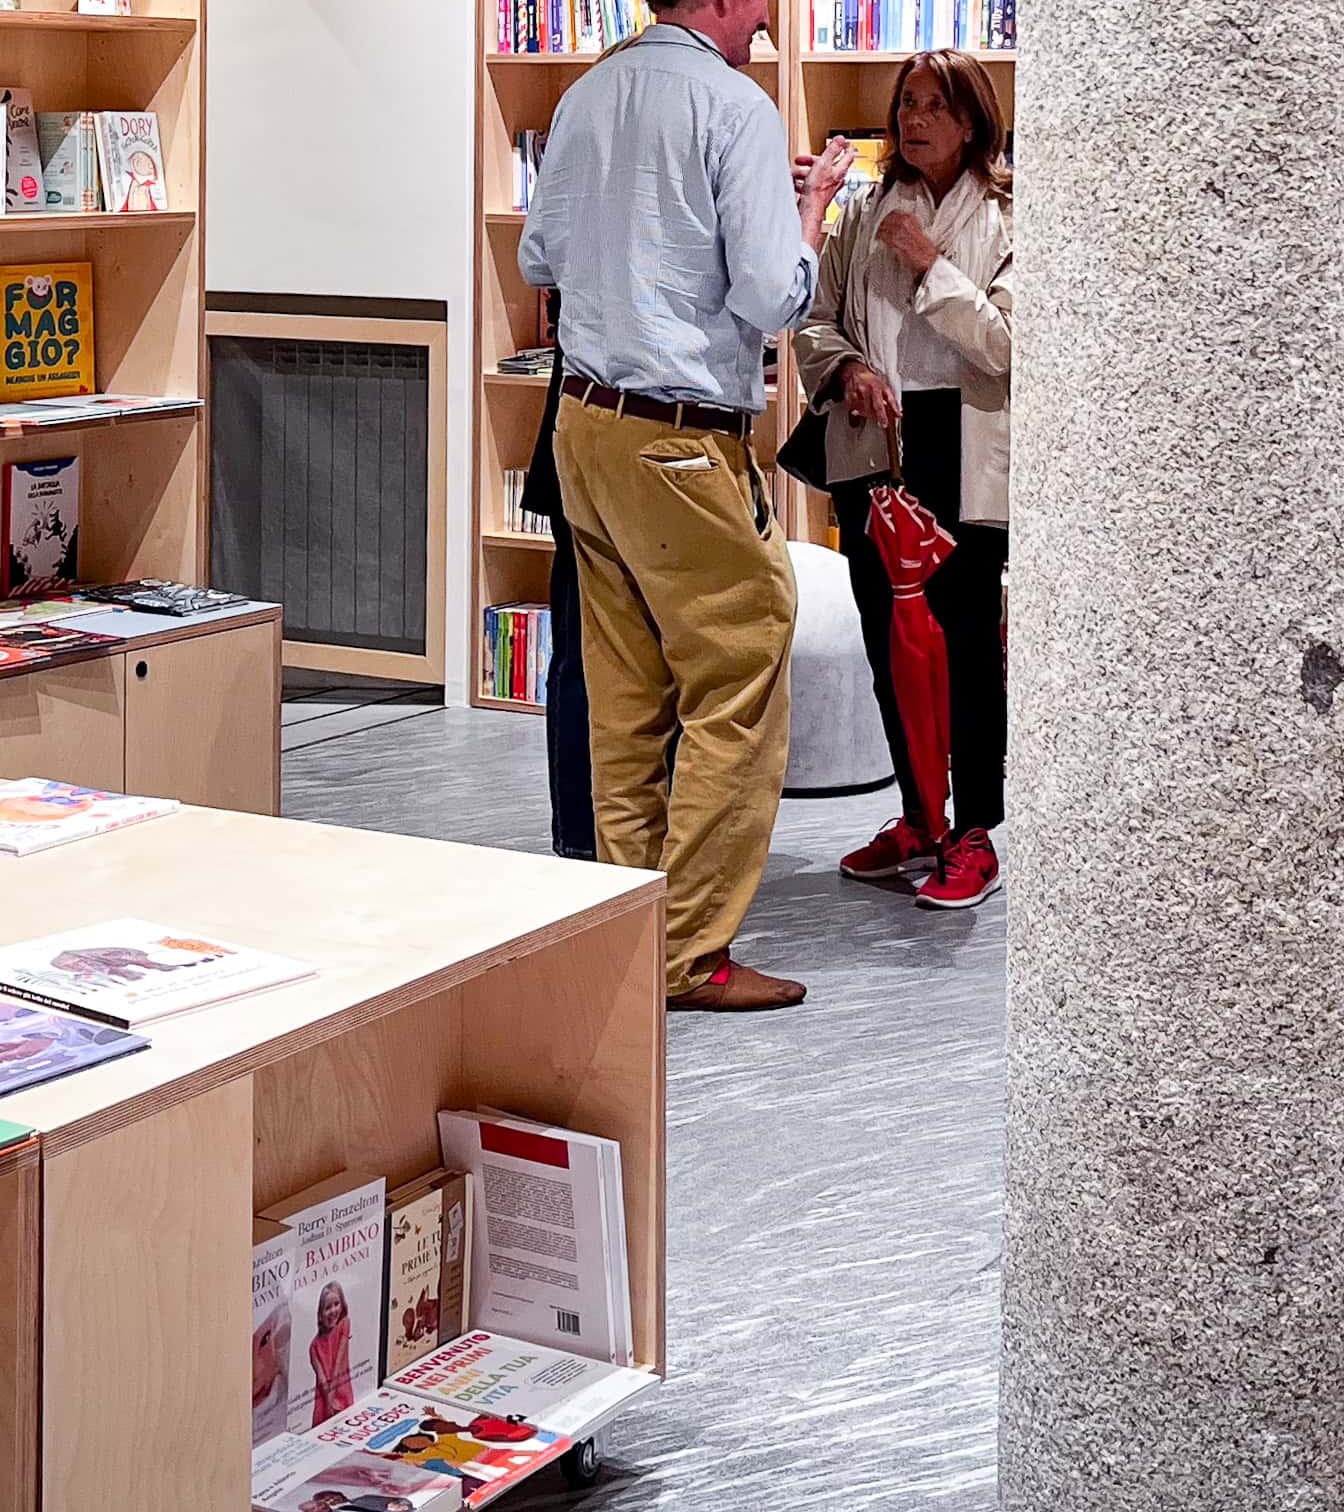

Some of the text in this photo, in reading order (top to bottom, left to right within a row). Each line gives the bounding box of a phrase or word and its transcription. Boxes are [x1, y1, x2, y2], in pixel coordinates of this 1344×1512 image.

[120, 116, 153, 137] DORY
[5, 280, 78, 312] FOR
[5, 310, 80, 339] MAG
[5, 339, 80, 370] GIO?
[297, 1192, 379, 1236] Berry Brazelton
[306, 1222, 380, 1269] BAMBINO
[342, 1247, 370, 1269] ANNI
[401, 1254, 427, 1276] PRIME
[395, 1332, 491, 1385] BENVENUTO
[413, 1348, 493, 1391] NEI PRIMI
[441, 1369, 484, 1395] ANNI
[455, 1353, 538, 1403] DELLA TUA
[474, 1384, 519, 1405] VITA
[345, 1406, 384, 1426] COSA
